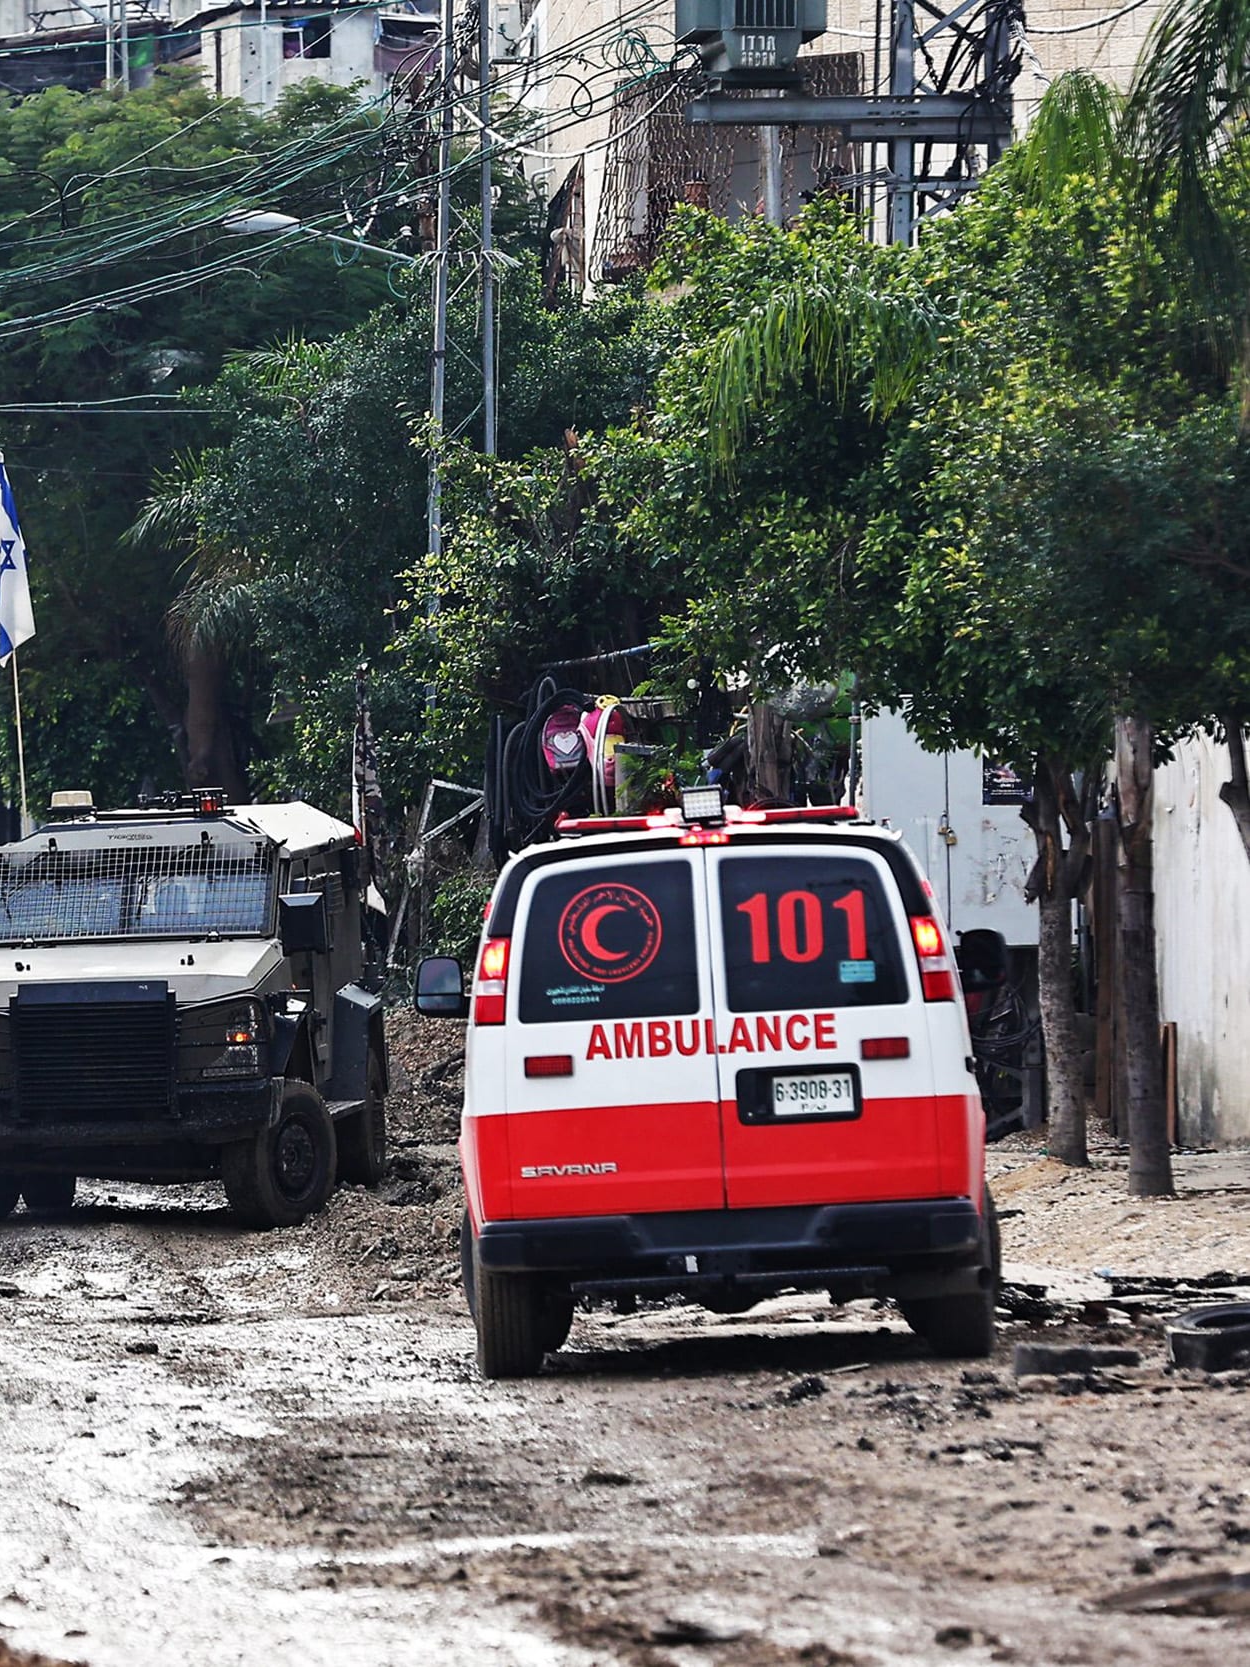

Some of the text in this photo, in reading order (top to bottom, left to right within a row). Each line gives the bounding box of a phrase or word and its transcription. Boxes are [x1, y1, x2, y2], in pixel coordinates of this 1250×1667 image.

[736, 889, 868, 963] 101
[585, 1012, 838, 1061] AMBULANCE
[521, 1162, 618, 1178] SAVANA
